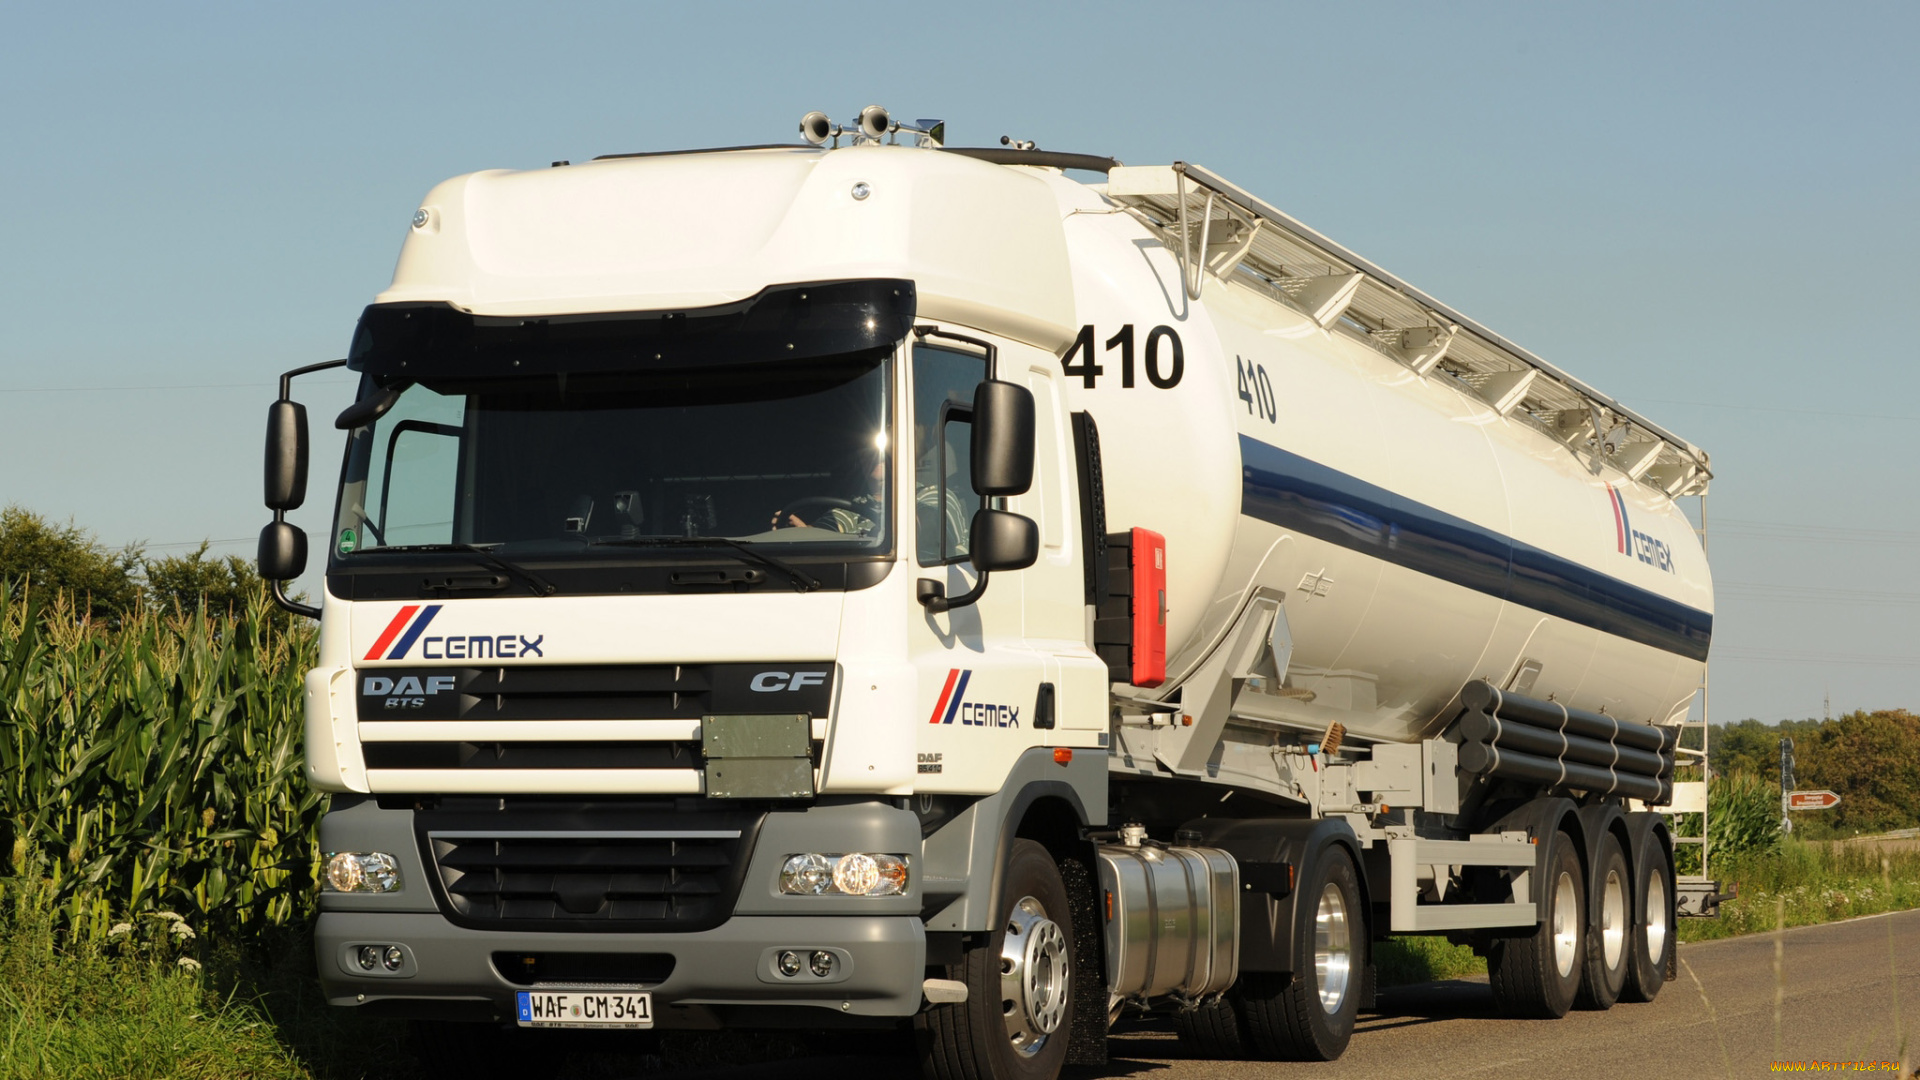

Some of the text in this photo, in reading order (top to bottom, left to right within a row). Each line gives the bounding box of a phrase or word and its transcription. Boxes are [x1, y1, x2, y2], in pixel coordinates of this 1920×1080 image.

[1060, 324, 1185, 389] 410
[1236, 354, 1277, 424] 410
[1632, 529, 1675, 575] CEMEX
[423, 634, 544, 660] CEMEX
[362, 676, 456, 696] DAF
[750, 671, 828, 693] CF
[384, 697, 426, 710] BTS
[962, 702, 1019, 729] CEMEX
[917, 753, 943, 763] DAF
[531, 996, 567, 1018] WAF
